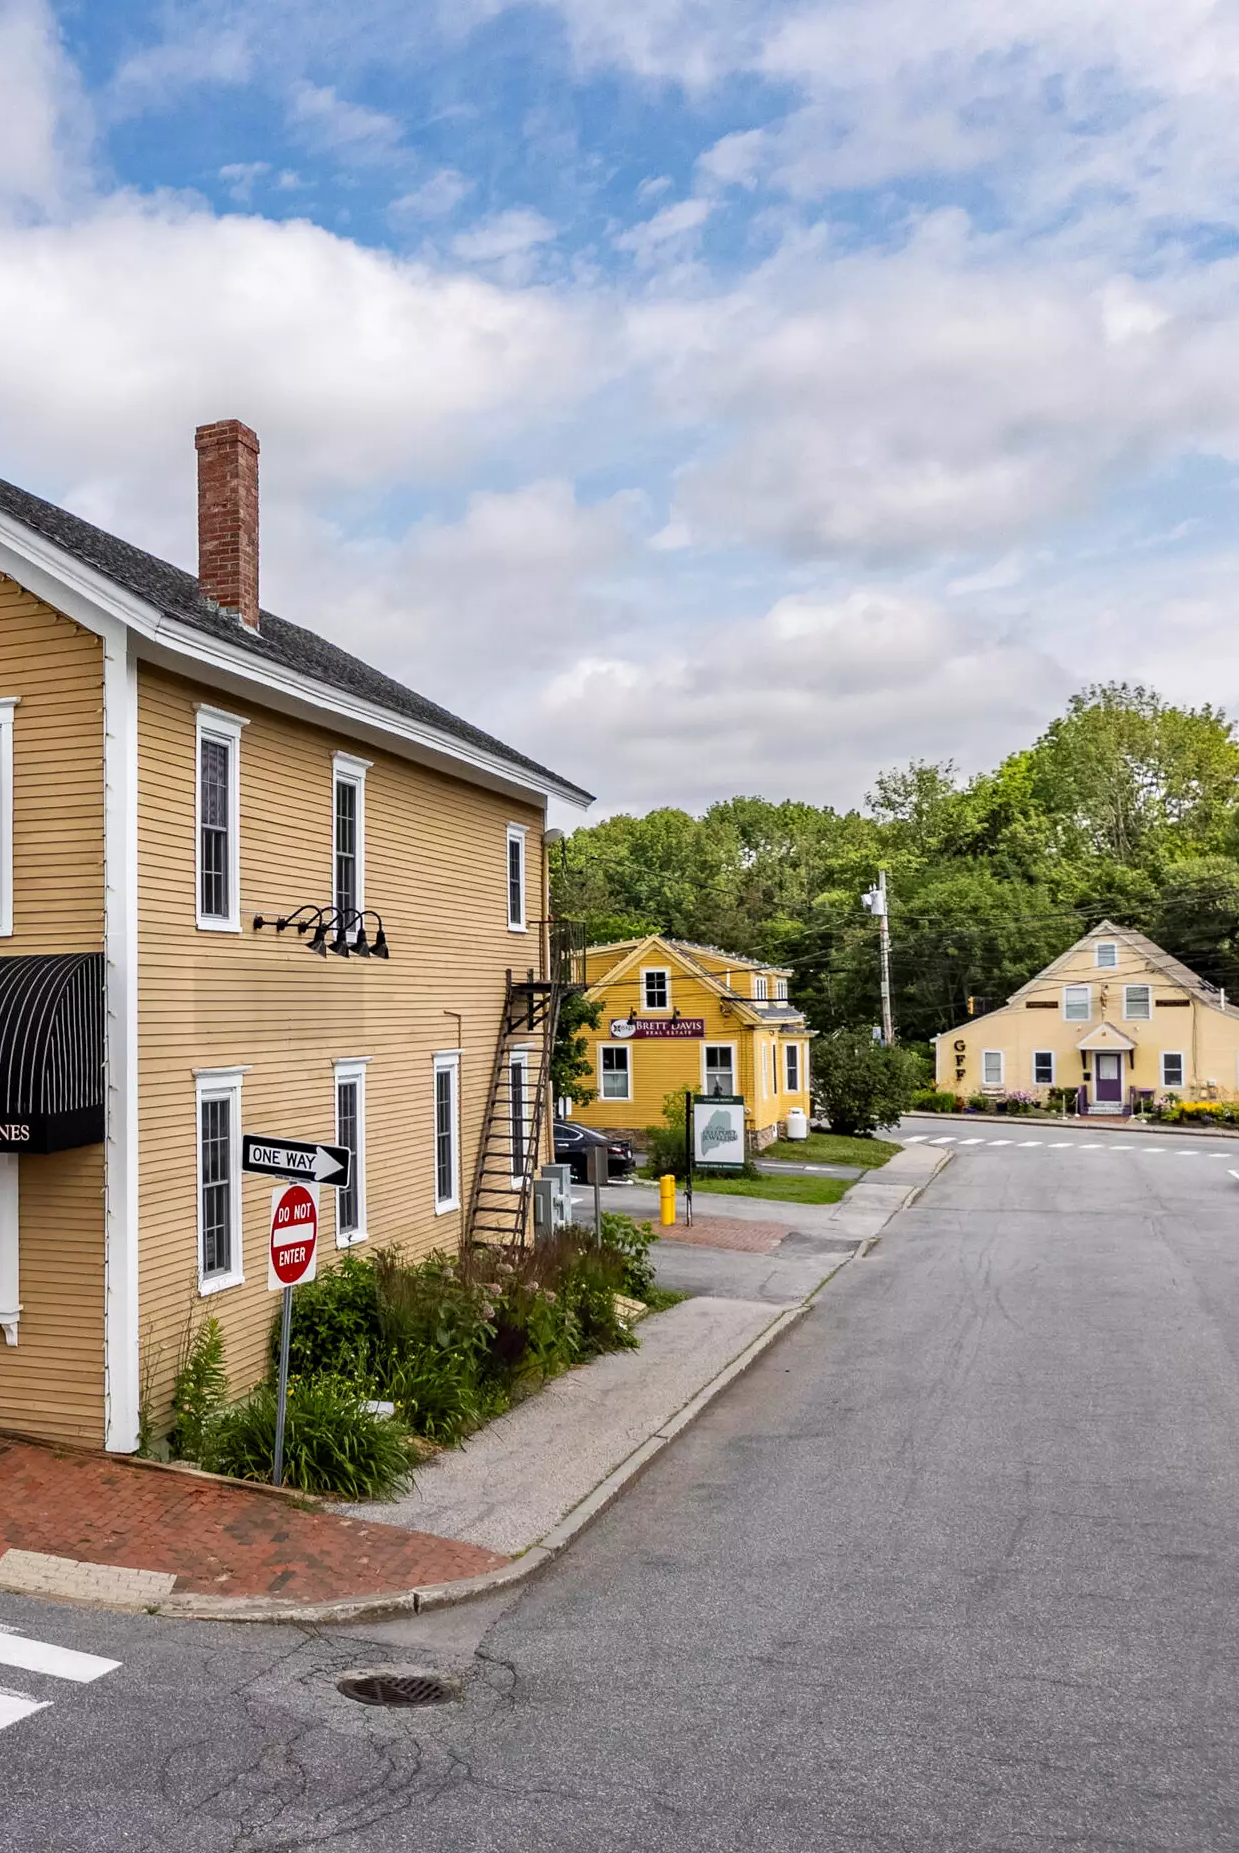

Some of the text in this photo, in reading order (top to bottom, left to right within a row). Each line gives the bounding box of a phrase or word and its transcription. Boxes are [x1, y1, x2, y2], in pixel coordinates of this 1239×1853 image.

[636, 1021, 701, 1030] BRETT DAVIS
[253, 1148, 316, 1170] ONE WAY
[278, 1203, 311, 1223] DO NOT
[279, 1247, 306, 1266] ENTER
